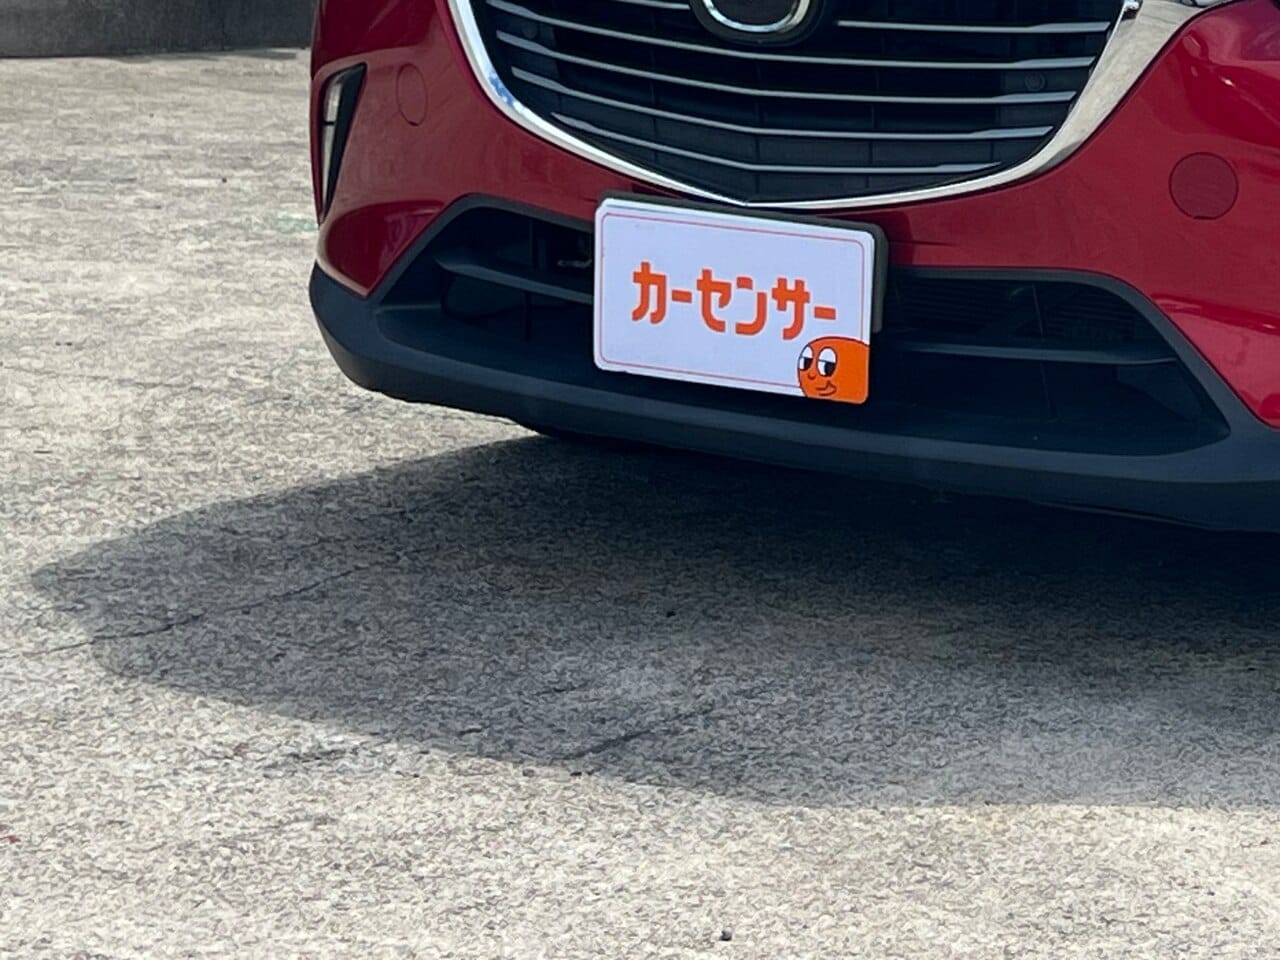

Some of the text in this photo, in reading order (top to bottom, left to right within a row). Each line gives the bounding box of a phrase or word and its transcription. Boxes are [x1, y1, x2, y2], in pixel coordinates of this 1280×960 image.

[632, 261, 837, 340] カーセンサー
